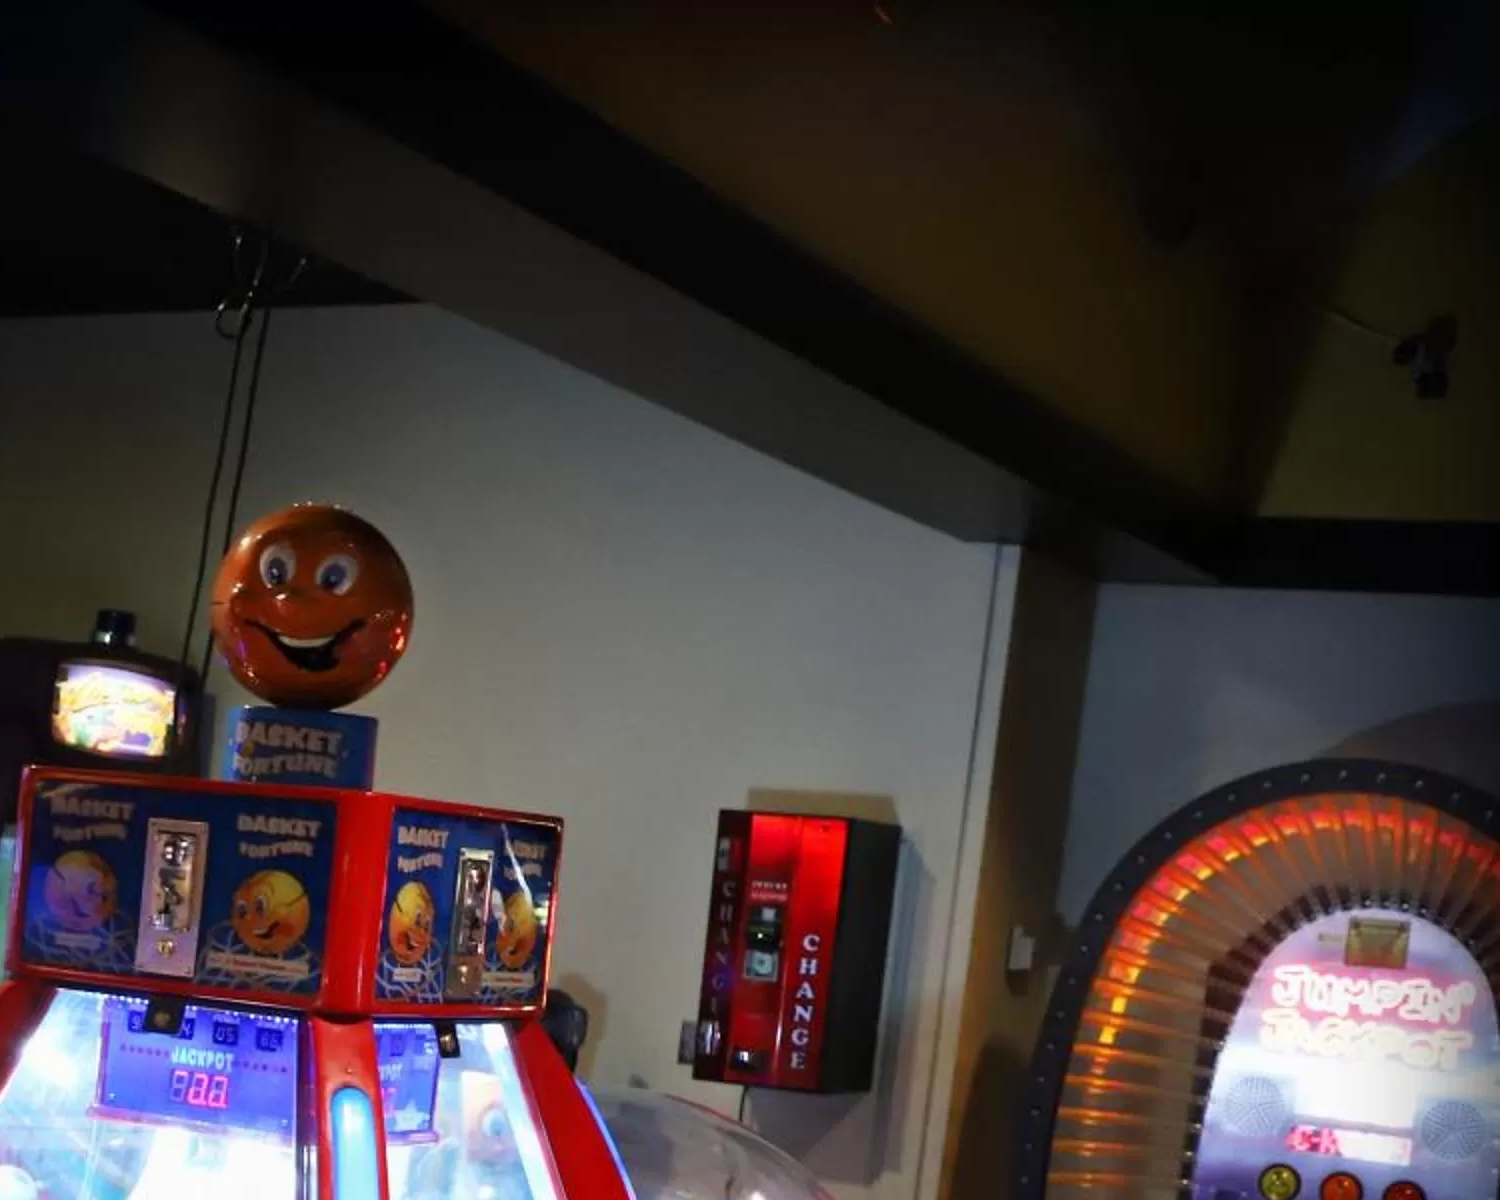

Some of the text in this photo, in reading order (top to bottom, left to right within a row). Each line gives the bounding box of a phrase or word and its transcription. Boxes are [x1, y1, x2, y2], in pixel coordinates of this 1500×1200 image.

[236, 721, 342, 755] BASKET
[233, 752, 337, 780] FORTUNE
[237, 813, 322, 838] BASKET
[789, 933, 821, 1070] CHANGE
[1260, 1007, 1476, 1072] JACKPOT
[170, 1045, 236, 1072] JACKPOT
